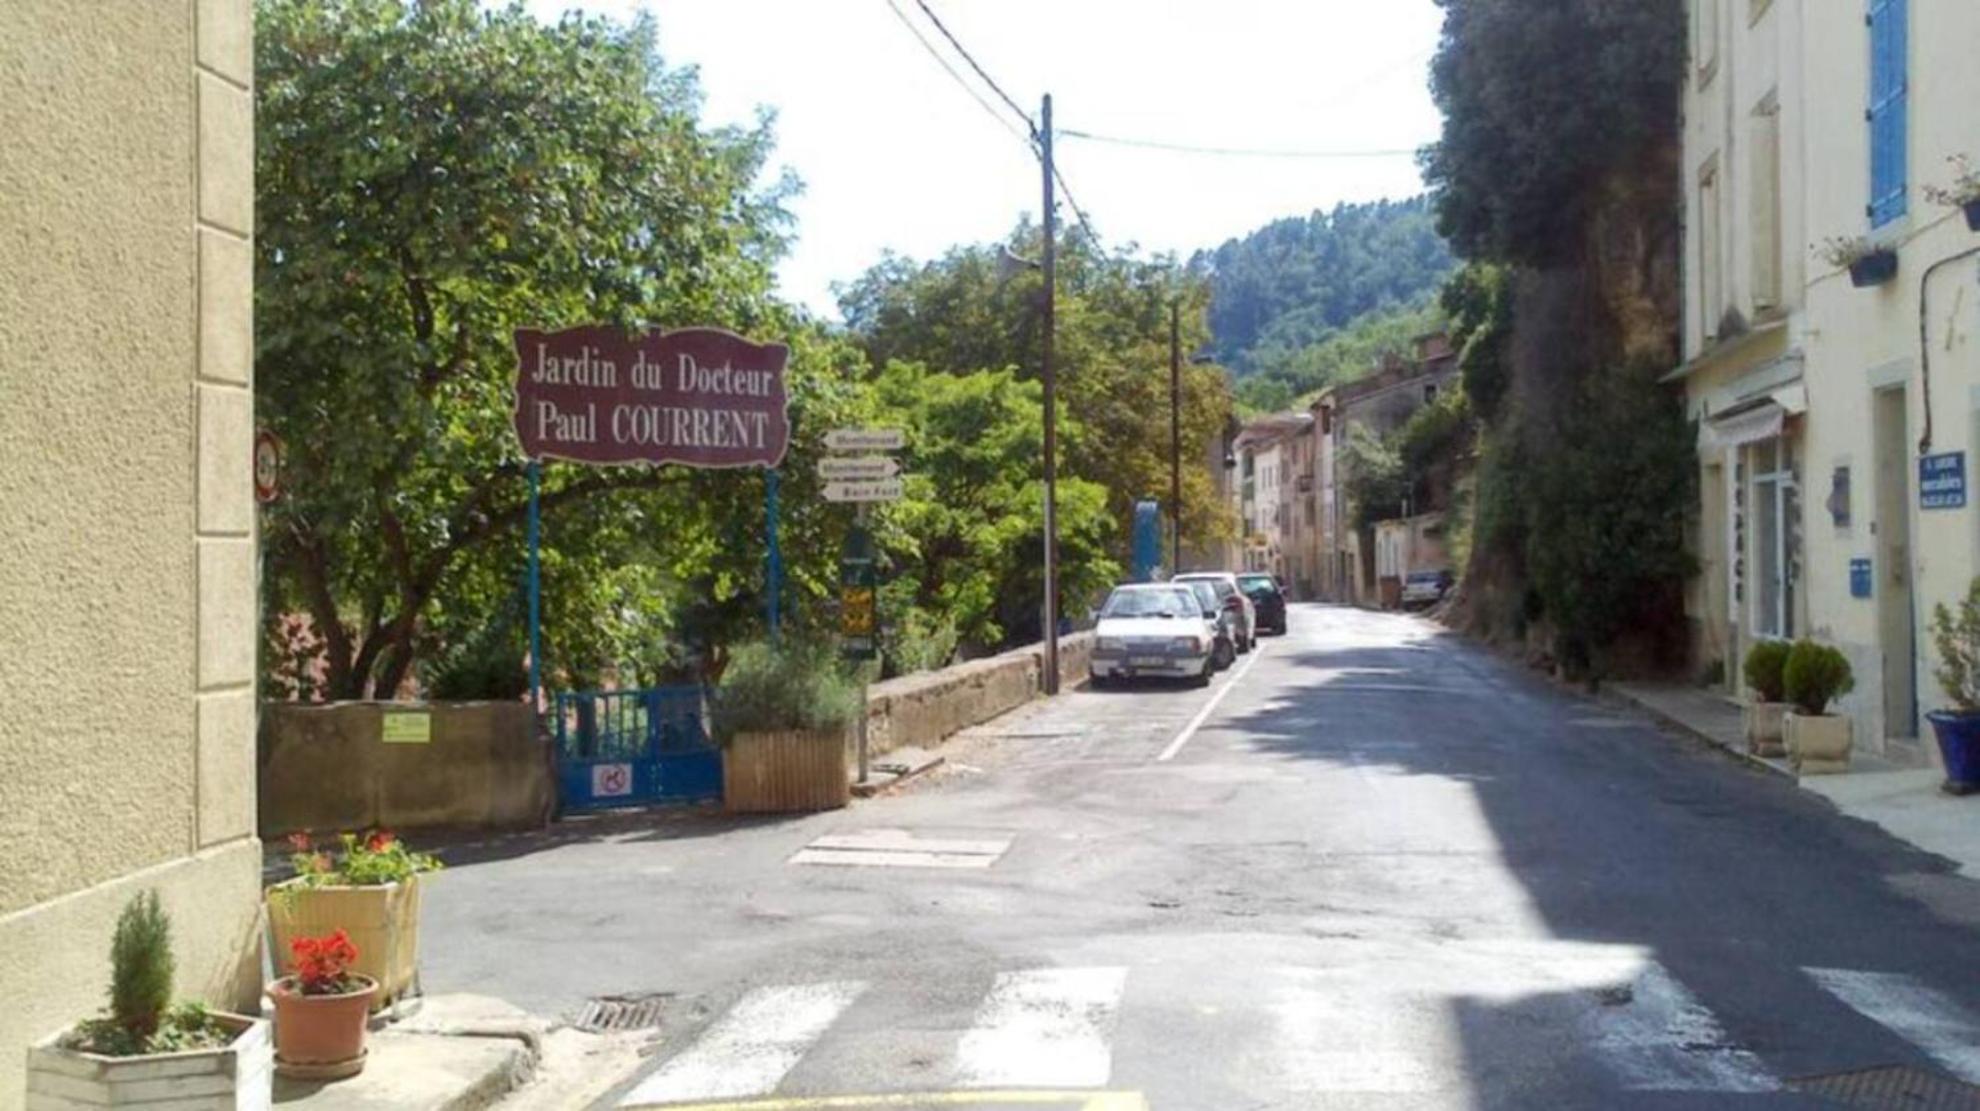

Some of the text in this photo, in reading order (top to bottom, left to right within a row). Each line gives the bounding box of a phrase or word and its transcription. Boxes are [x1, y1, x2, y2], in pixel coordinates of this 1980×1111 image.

[532, 343, 774, 396] Jardin du Docteur
[537, 401, 769, 449] Paul COURRENT
